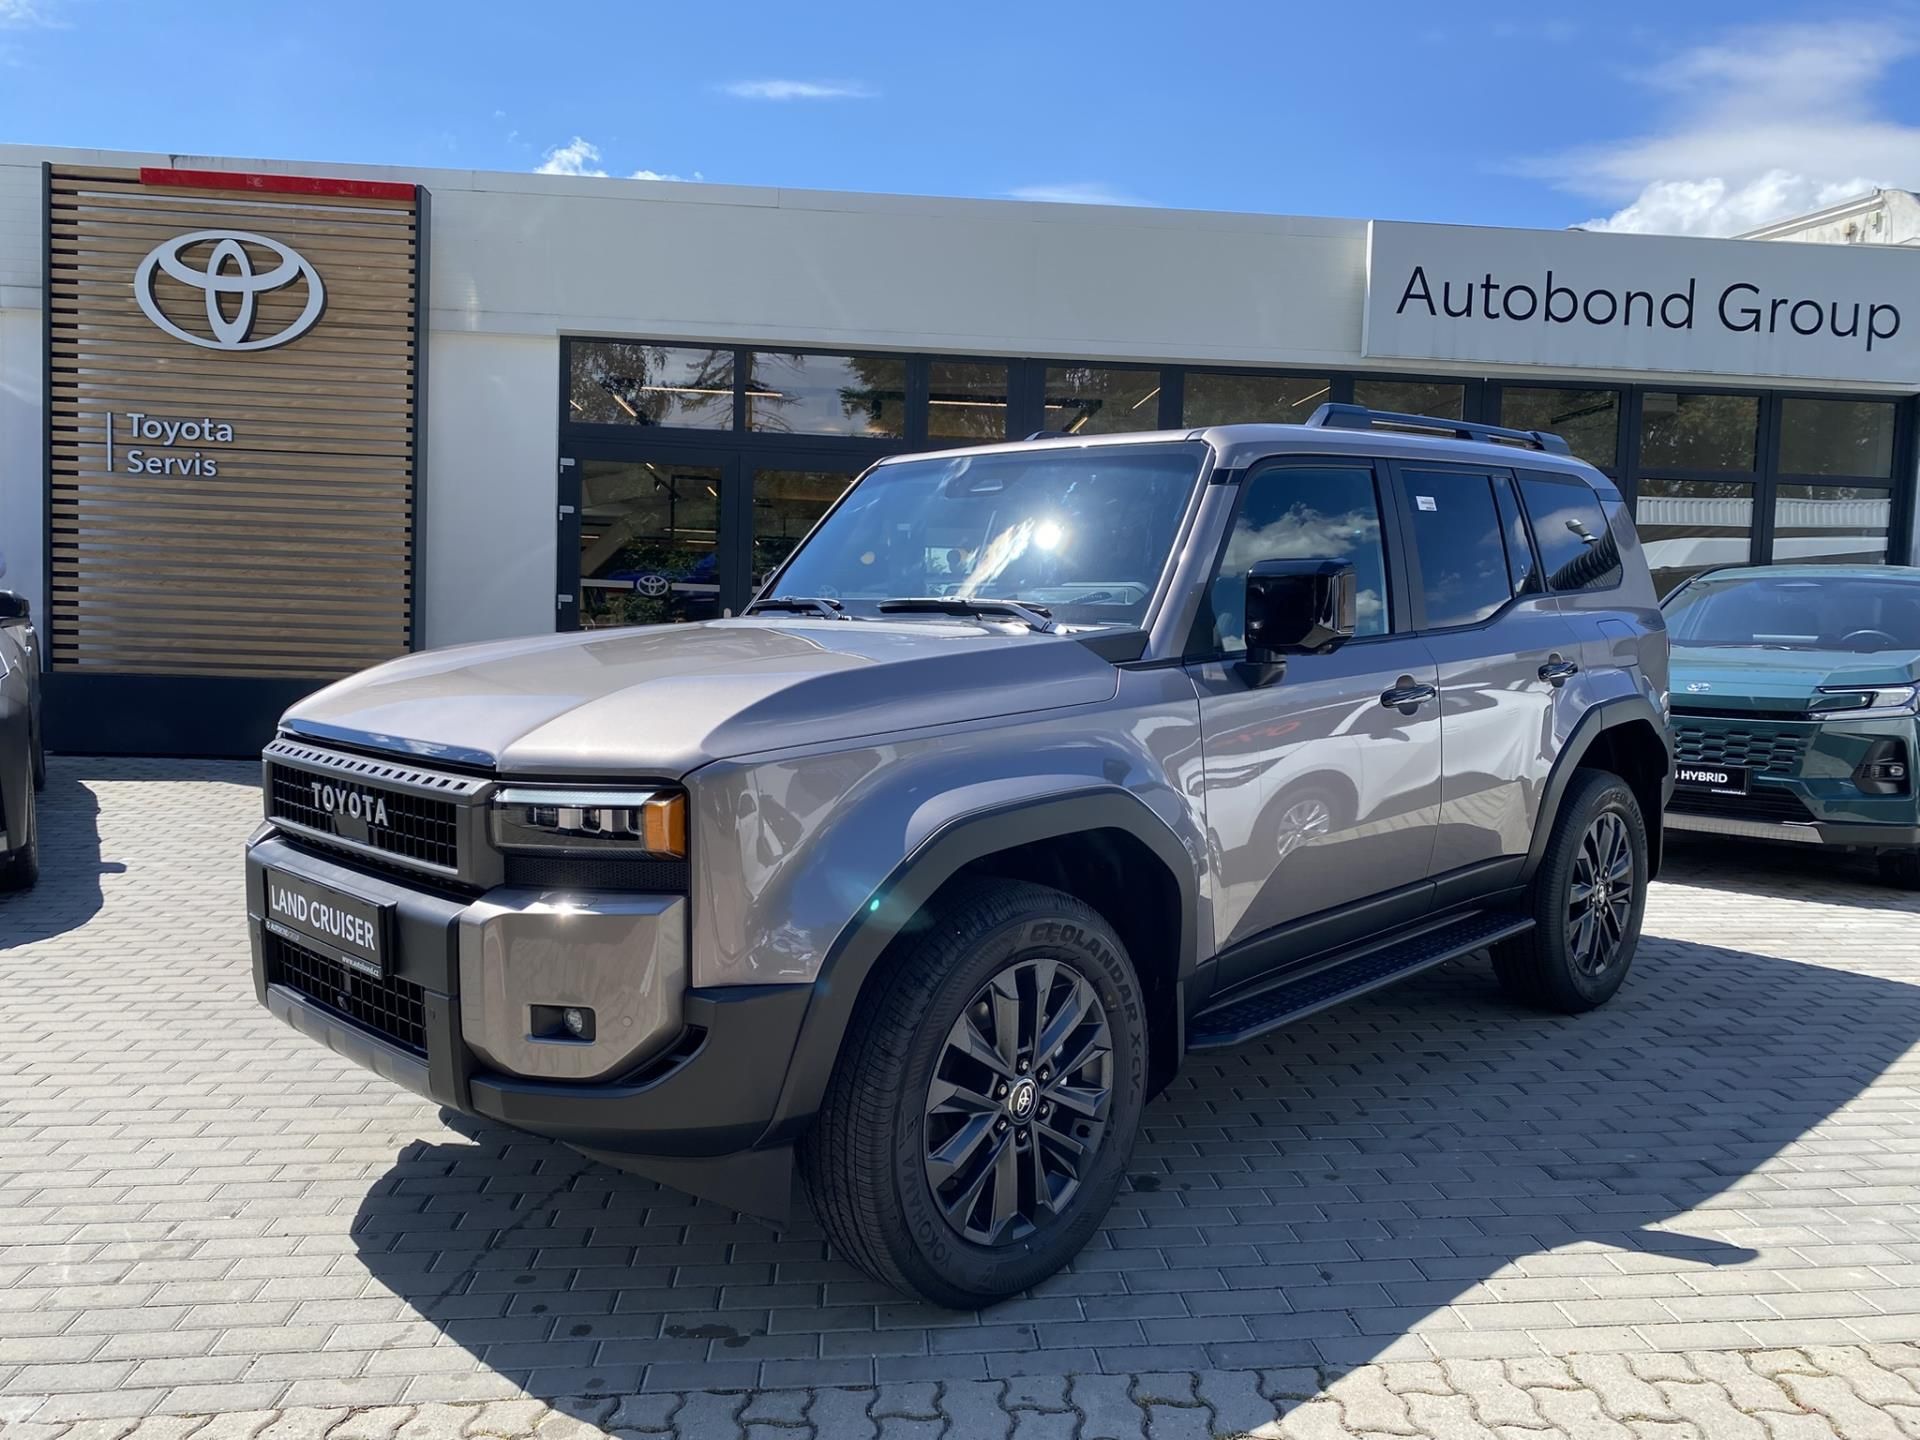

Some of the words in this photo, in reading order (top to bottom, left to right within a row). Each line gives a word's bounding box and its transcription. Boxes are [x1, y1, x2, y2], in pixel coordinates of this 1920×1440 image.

[1396, 266, 1696, 329] Autobond
[1718, 283, 1901, 352] Group
[126, 413, 234, 446] Toyota
[127, 450, 217, 477] Servis
[1680, 769, 1728, 783] HYBRID
[311, 782, 389, 827] TOYOTA
[271, 885, 308, 921] LAND
[310, 901, 376, 951] CRUISER
[1030, 922, 1138, 1024] GEOLANDAR
